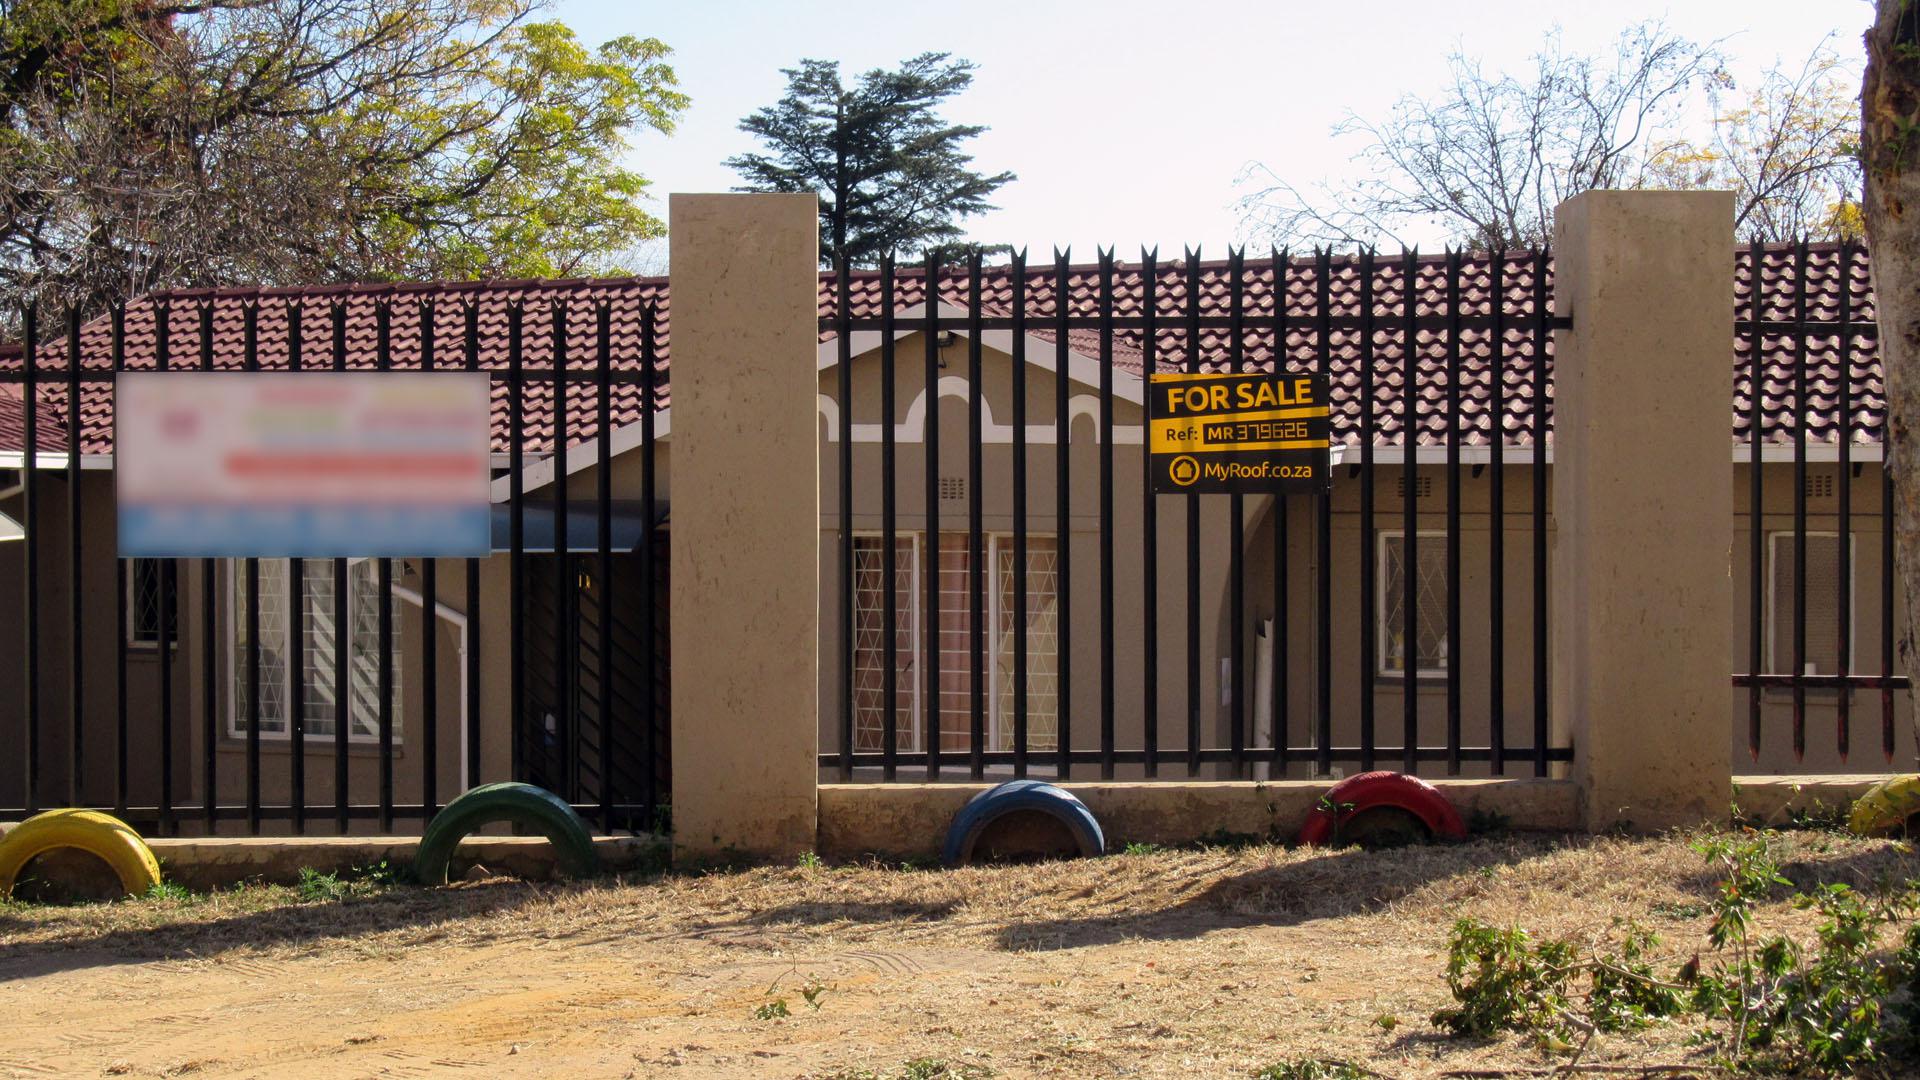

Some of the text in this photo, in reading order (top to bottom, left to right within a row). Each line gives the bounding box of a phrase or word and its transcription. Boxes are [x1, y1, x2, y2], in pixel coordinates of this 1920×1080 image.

[1167, 379, 1313, 413] FOR SALE
[1166, 422, 1308, 441] Ref: MR 379626
[1204, 461, 1312, 481] MyRoof.co.za
